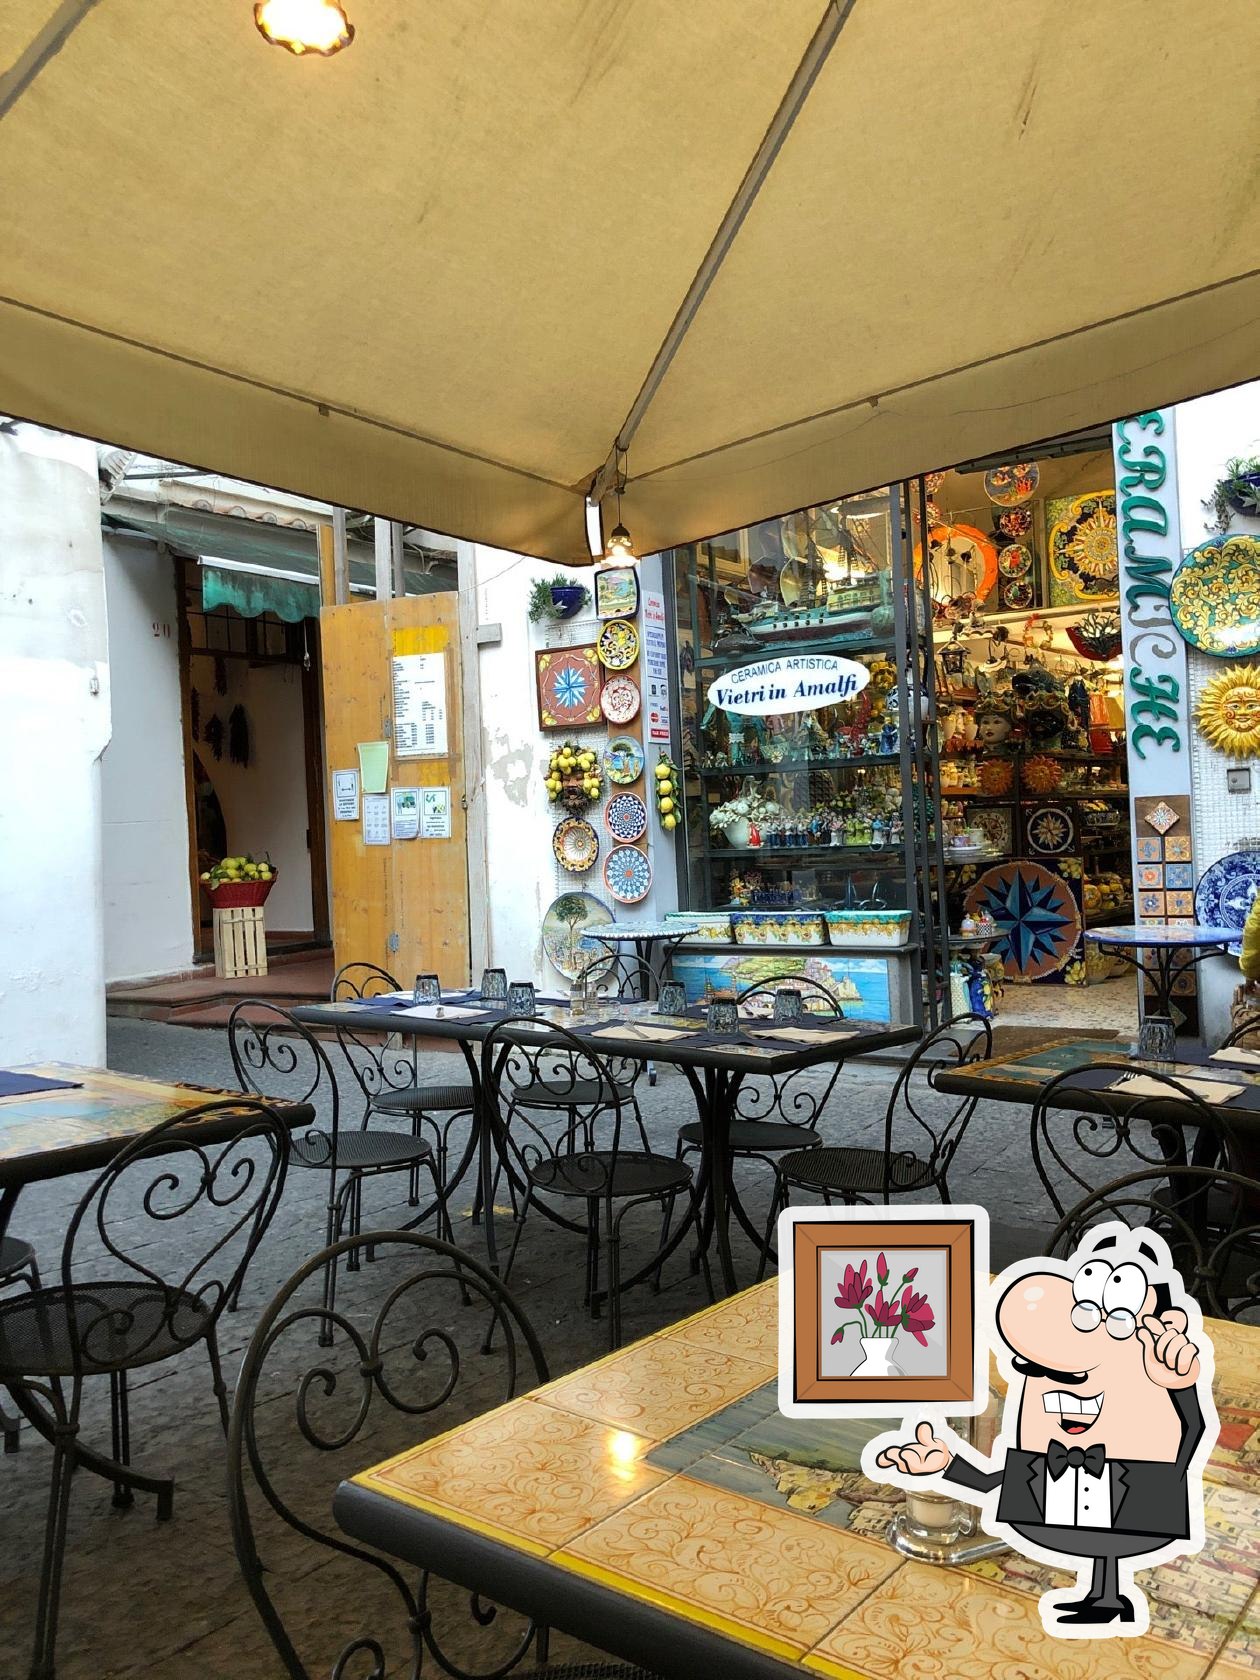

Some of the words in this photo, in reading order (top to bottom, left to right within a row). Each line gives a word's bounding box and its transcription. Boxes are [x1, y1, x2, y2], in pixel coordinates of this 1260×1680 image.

[731, 661, 782, 685] CERAMICA
[786, 658, 839, 671] ARTISTICA
[716, 684, 765, 706] Vietri
[768, 683, 787, 700] in
[793, 673, 859, 698] Amalfi
